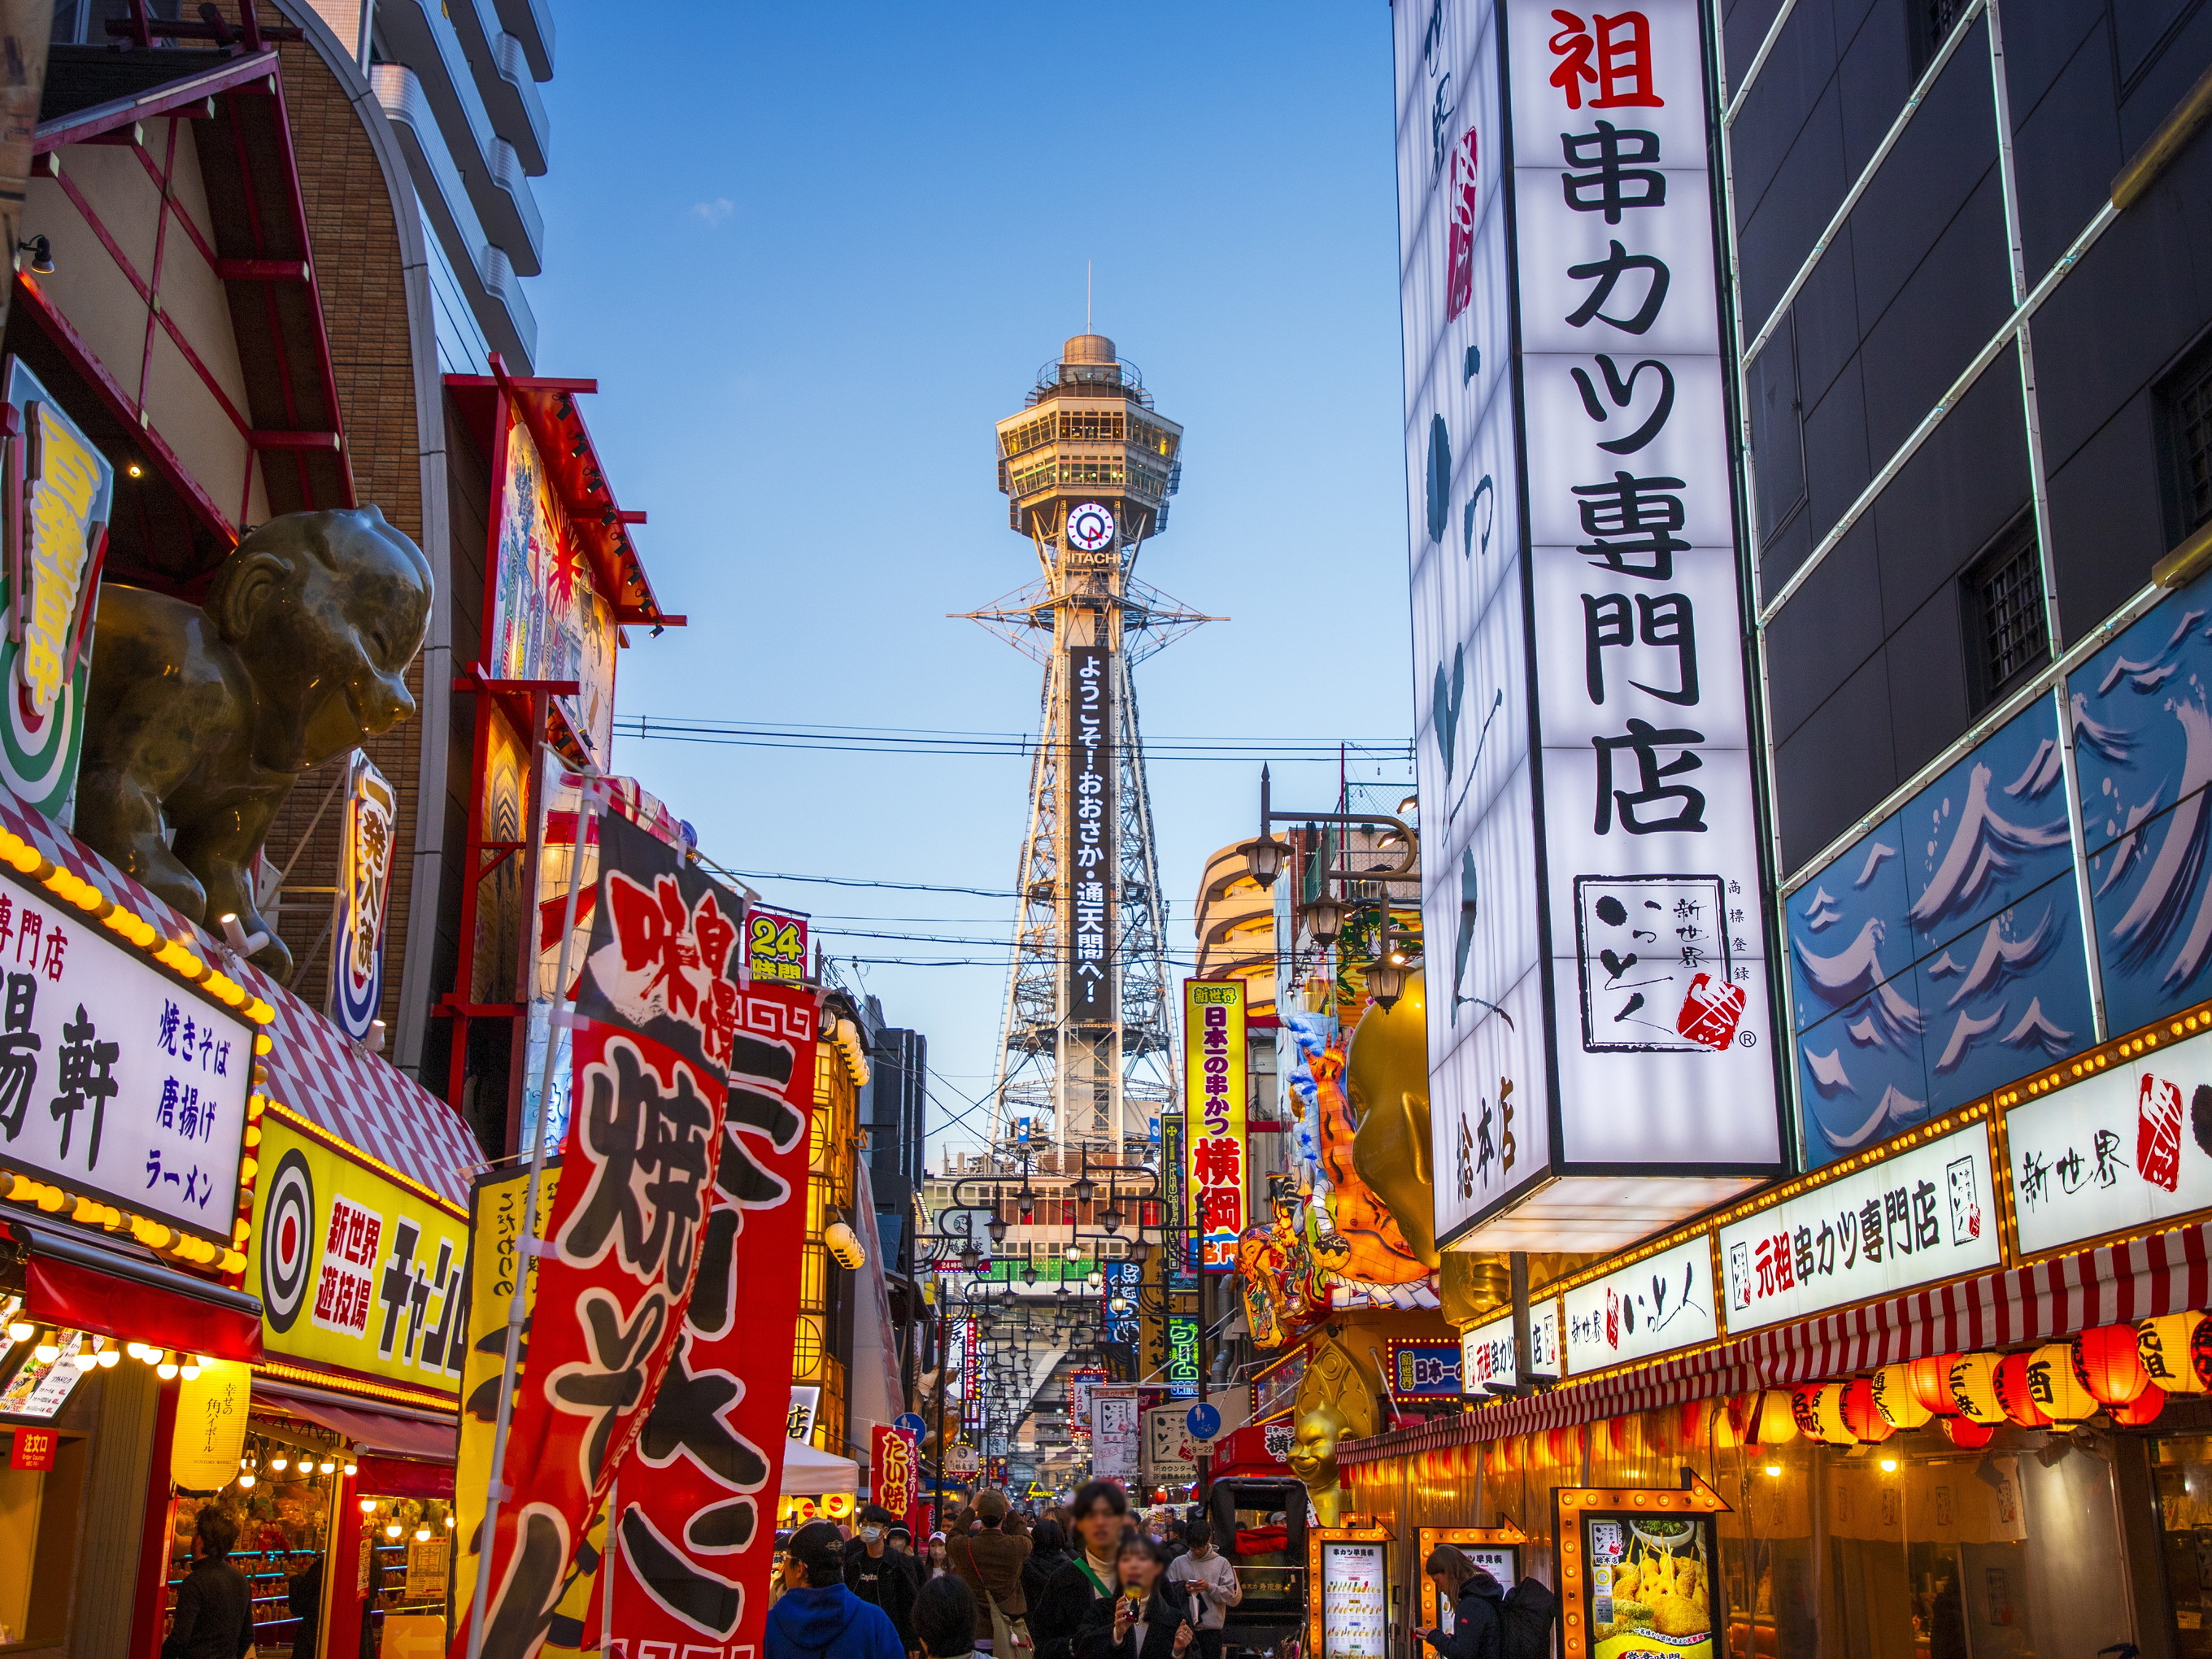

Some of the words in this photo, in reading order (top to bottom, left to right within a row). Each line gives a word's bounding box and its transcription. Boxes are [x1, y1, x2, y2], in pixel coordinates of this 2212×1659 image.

[1548, 8, 1709, 836] 祖串カツ専門店
[1060, 553, 1121, 564] HITACHI
[752, 919, 803, 960] 24
[1673, 898, 1709, 968] 新世界
[1727, 880, 1750, 982] 商標登録
[1194, 988, 1237, 1004] 新世界
[157, 998, 230, 1078] 焼きそば
[1204, 1006, 1230, 1136] 日本一の串かつ
[156, 1075, 216, 1143] 唐揚げ
[146, 1149, 213, 1210] ラーメン
[1193, 1139, 1240, 1235] 横綱
[2020, 1130, 2129, 1213] 新世界
[327, 1201, 381, 1269] 新世界
[1754, 1179, 1940, 1300] 元祖串カツ専門店
[314, 1264, 372, 1332] 遊技場
[380, 1221, 462, 1372] チャン
[1571, 1310, 1604, 1344] 新世界
[222, 1382, 237, 1415] 幸せの
[1400, 1352, 1414, 1390] 新世界
[24, 1434, 48, 1452] 注文口
[203, 1398, 221, 1452] 角ハイボール
[1266, 1435, 1295, 1454] 横
